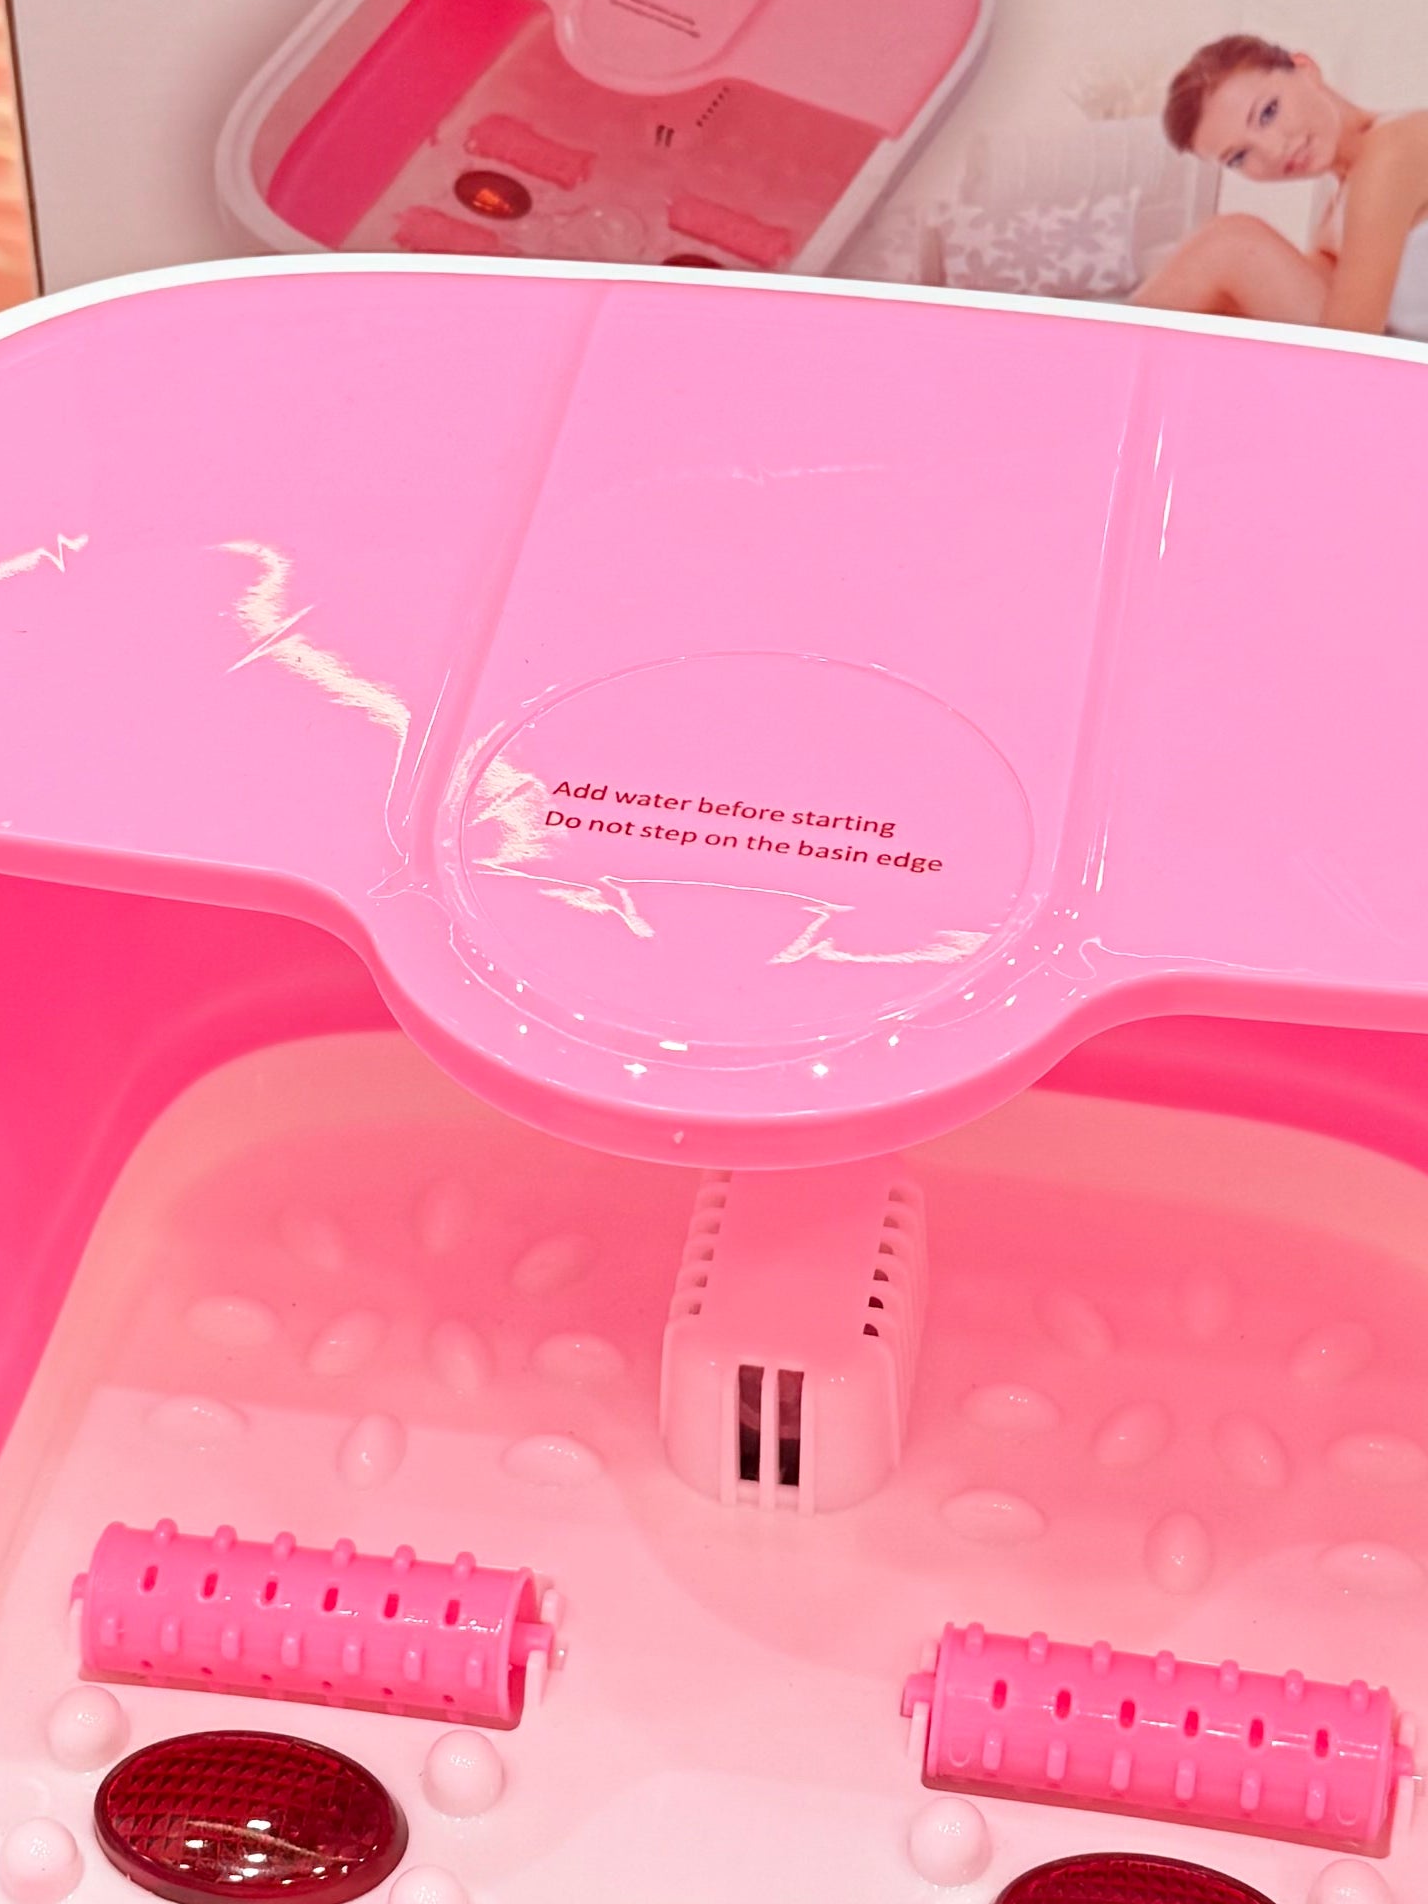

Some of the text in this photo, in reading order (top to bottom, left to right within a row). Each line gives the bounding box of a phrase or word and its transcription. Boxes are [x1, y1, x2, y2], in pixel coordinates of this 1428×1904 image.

[553, 780, 897, 839] Add water before starting
[544, 810, 944, 874] Do not step on the basin edge
